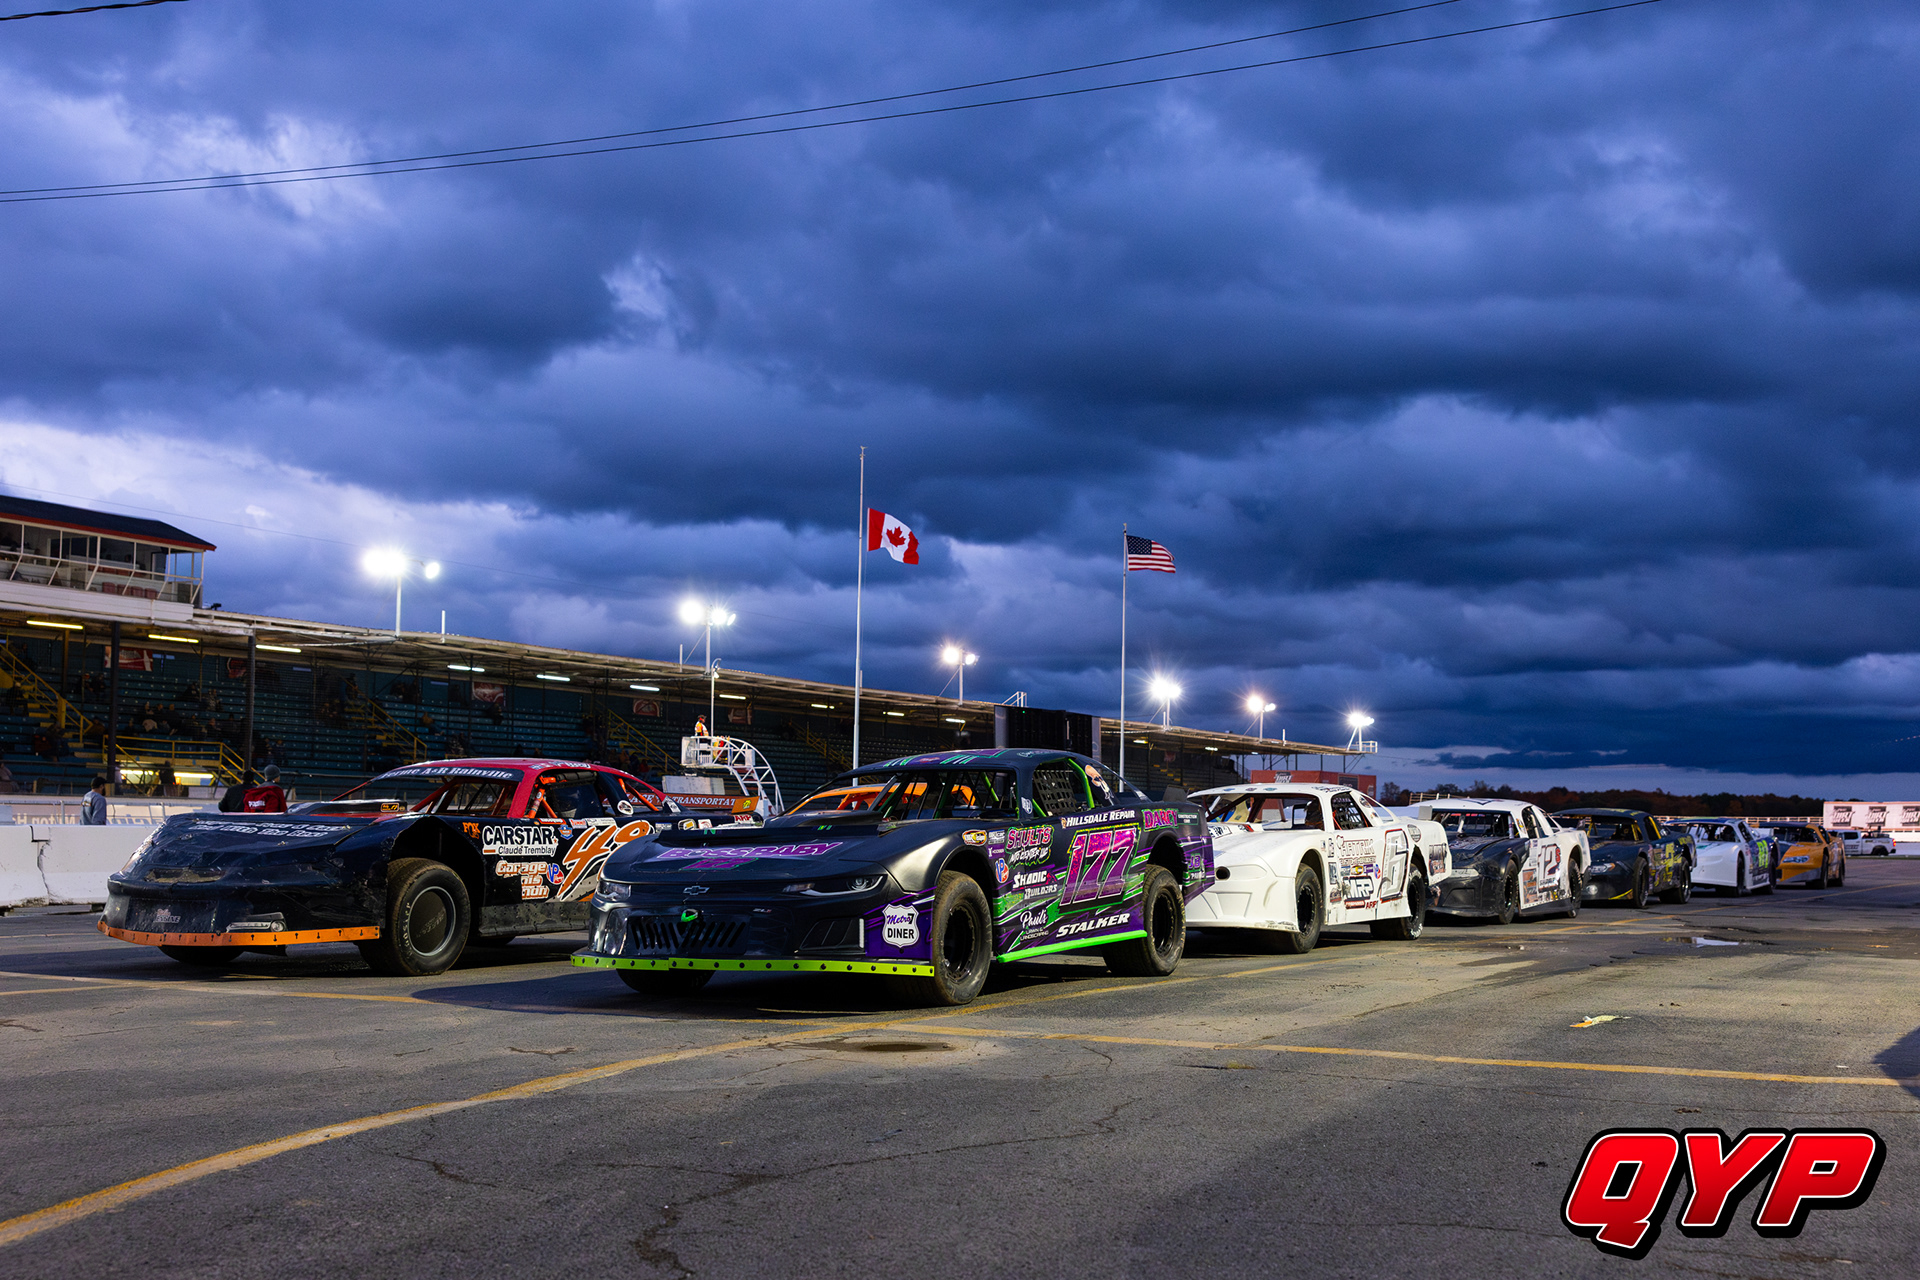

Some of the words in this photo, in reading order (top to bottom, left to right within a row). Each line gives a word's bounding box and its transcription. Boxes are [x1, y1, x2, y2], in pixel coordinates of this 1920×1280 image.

[421, 767, 447, 776] A&R
[450, 767, 512, 779] Rainville
[672, 796, 736, 806] TRANSPORTAT
[1066, 812, 1108, 827] HILLSDALE
[1109, 809, 1135, 821] REPAIR
[1144, 809, 1178, 829] DARCY
[463, 822, 480, 833] FOX
[483, 827, 554, 846] CARSTAR
[1006, 827, 1052, 850] SHULTS
[498, 846, 523, 855] Claude
[524, 846, 556, 857] Tremblay
[496, 861, 548, 877] Garage
[1058, 827, 1137, 906] 177
[1188, 855, 1201, 869] JB
[521, 874, 543, 886] nis
[1013, 871, 1047, 888] SHADIC
[1024, 884, 1058, 900] BUILDERS
[1021, 909, 1048, 929] Paul's
[1056, 913, 1130, 938] STALKER
[887, 928, 915, 939] DINER
